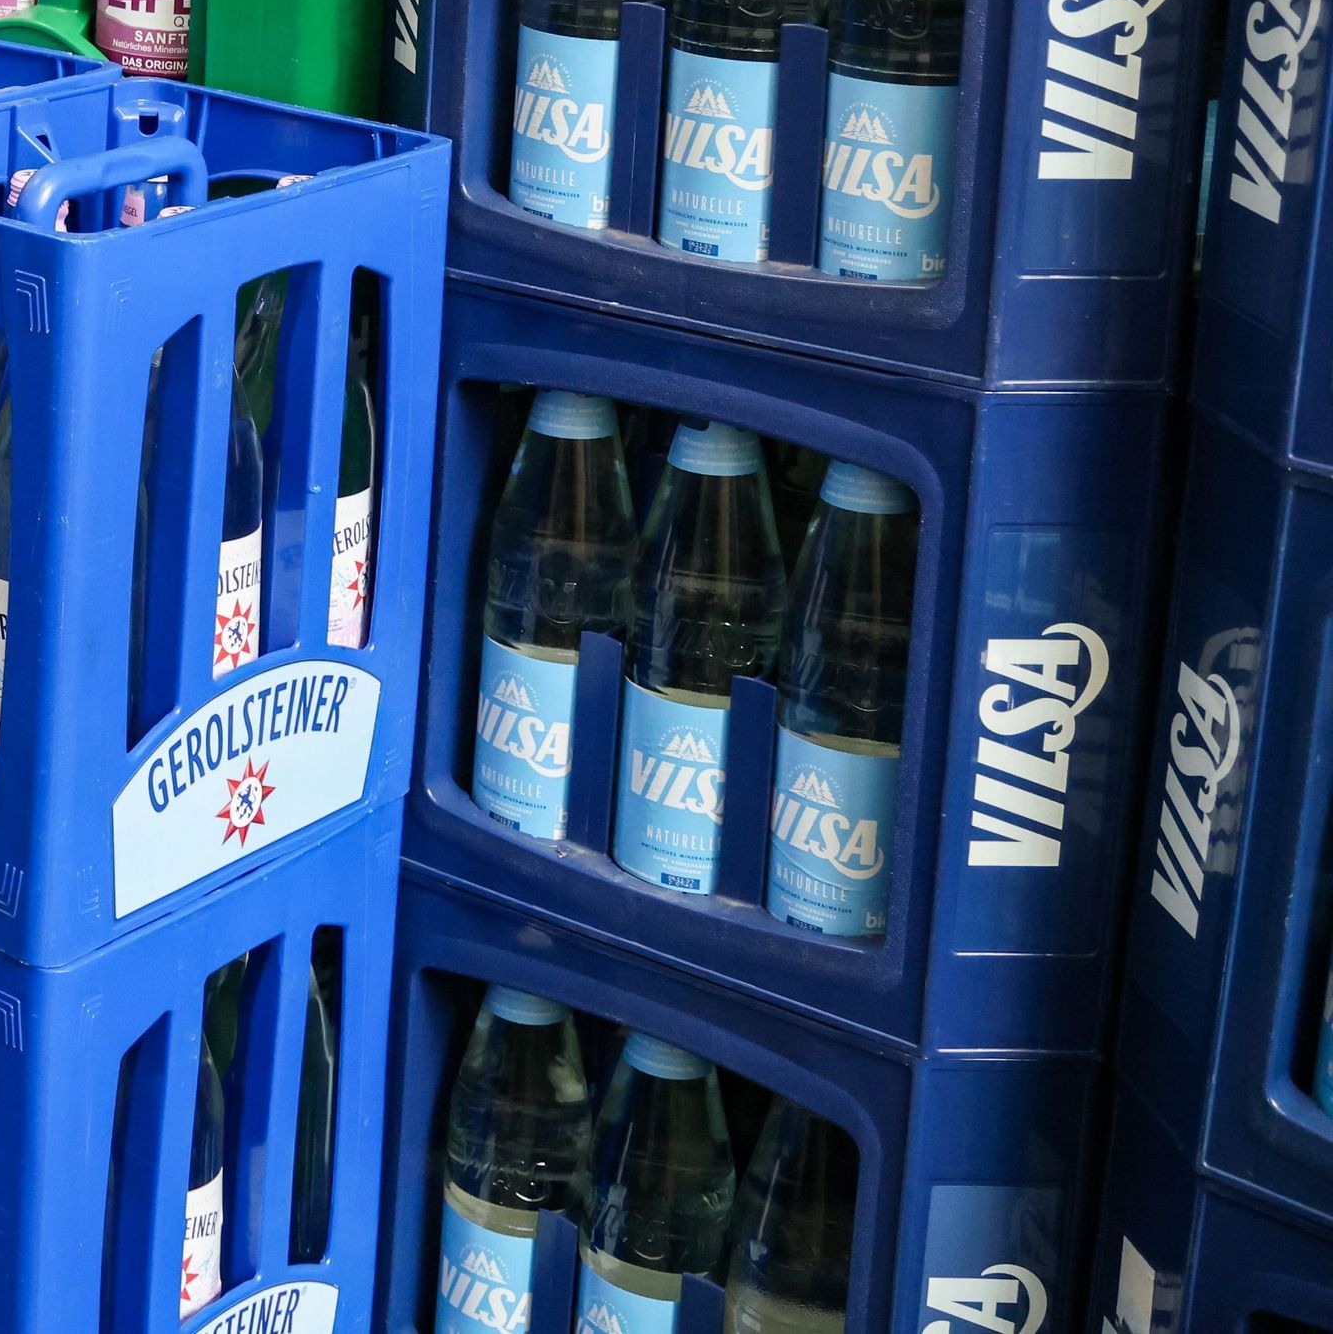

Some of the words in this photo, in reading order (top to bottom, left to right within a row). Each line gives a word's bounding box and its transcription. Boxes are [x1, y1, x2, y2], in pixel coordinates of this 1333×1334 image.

[113, 37, 152, 52] Natürliches
[134, 30, 188, 45] SANFT
[122, 55, 143, 67] DAS
[145, 57, 189, 71] ORIGINA
[665, 111, 775, 192] VILSA
[516, 159, 576, 187] NATURELLE
[592, 194, 610, 213] bi
[671, 189, 745, 216] NATURELLE
[828, 216, 902, 245] NATURELLE
[148, 675, 350, 813] GEROLSTEINER
[968, 622, 1110, 866] VILSA
[481, 763, 543, 799] NATURELLE
[631, 748, 726, 826] VILS
[1151, 660, 1241, 940] VILSA
[776, 862, 848, 903] NATURELLE
